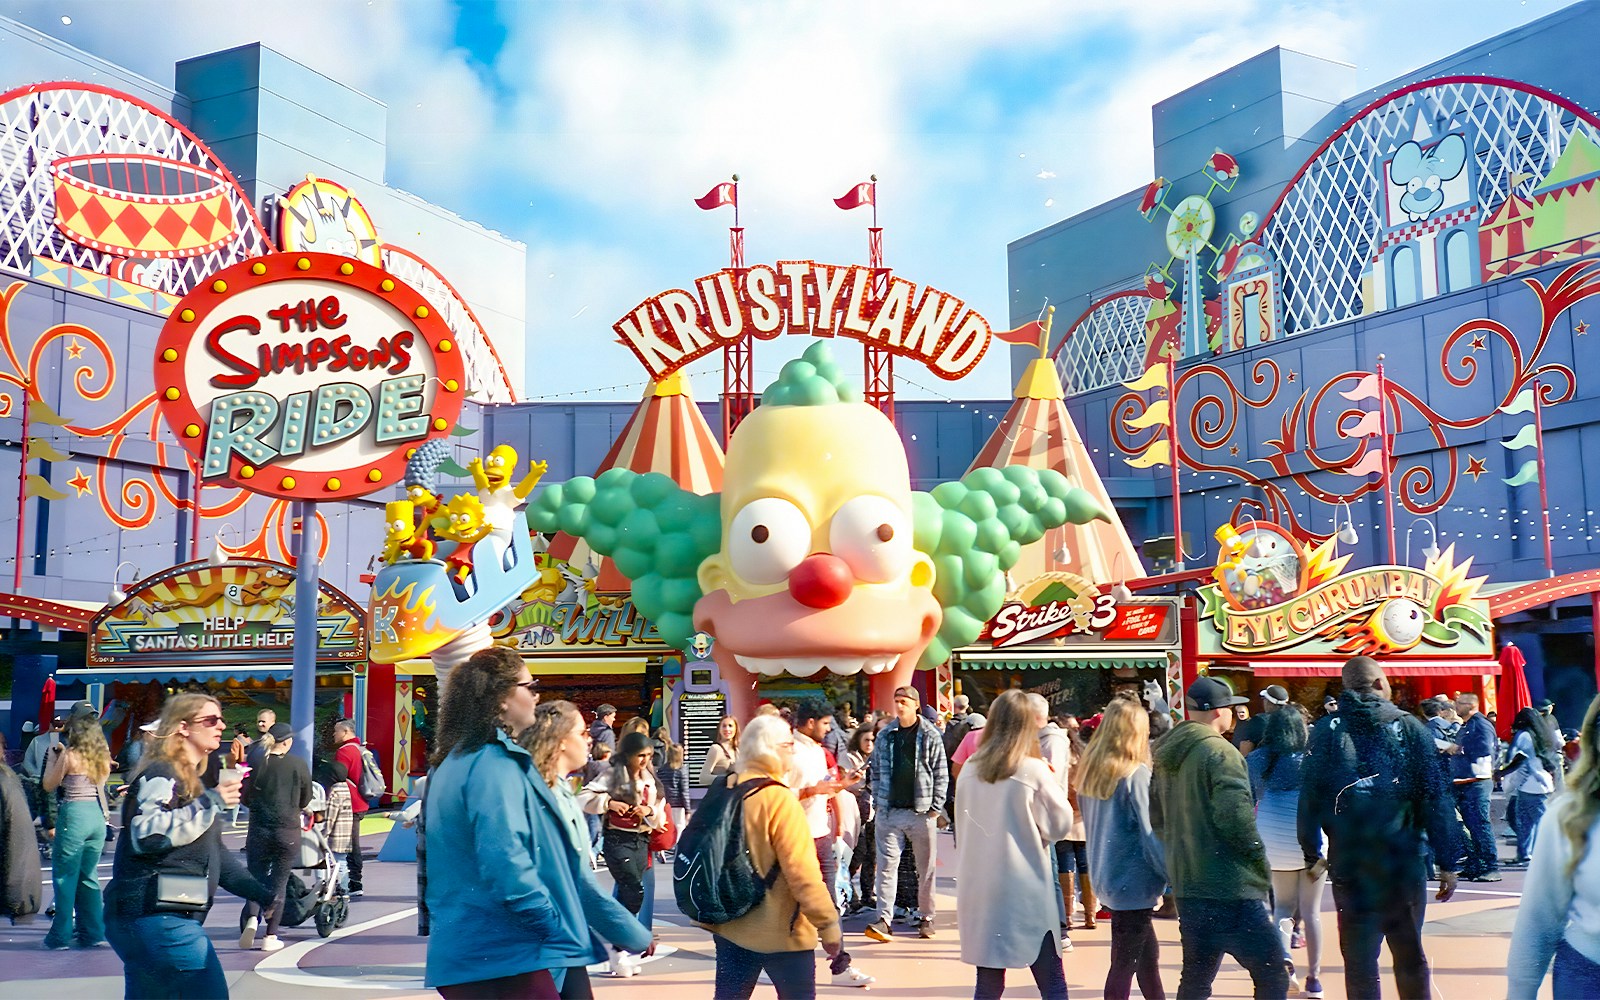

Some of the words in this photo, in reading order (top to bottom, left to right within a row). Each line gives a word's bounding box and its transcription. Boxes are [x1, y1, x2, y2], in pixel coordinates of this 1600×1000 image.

[718, 184, 732, 203] K
[858, 184, 871, 203] K
[618, 262, 989, 376] KRUSTYLAND
[203, 373, 432, 481] RIDE
[991, 601, 1073, 639] Strike
[1092, 595, 1117, 628] 3
[1227, 613, 1290, 646] EYE
[1287, 570, 1433, 634] CARUMBA!
[203, 616, 245, 631] HELP
[374, 606, 399, 644] K
[521, 627, 555, 646] AND
[135, 634, 198, 649] SANTA'S
[201, 633, 252, 648] LITTLE
[255, 633, 294, 646] HELP
